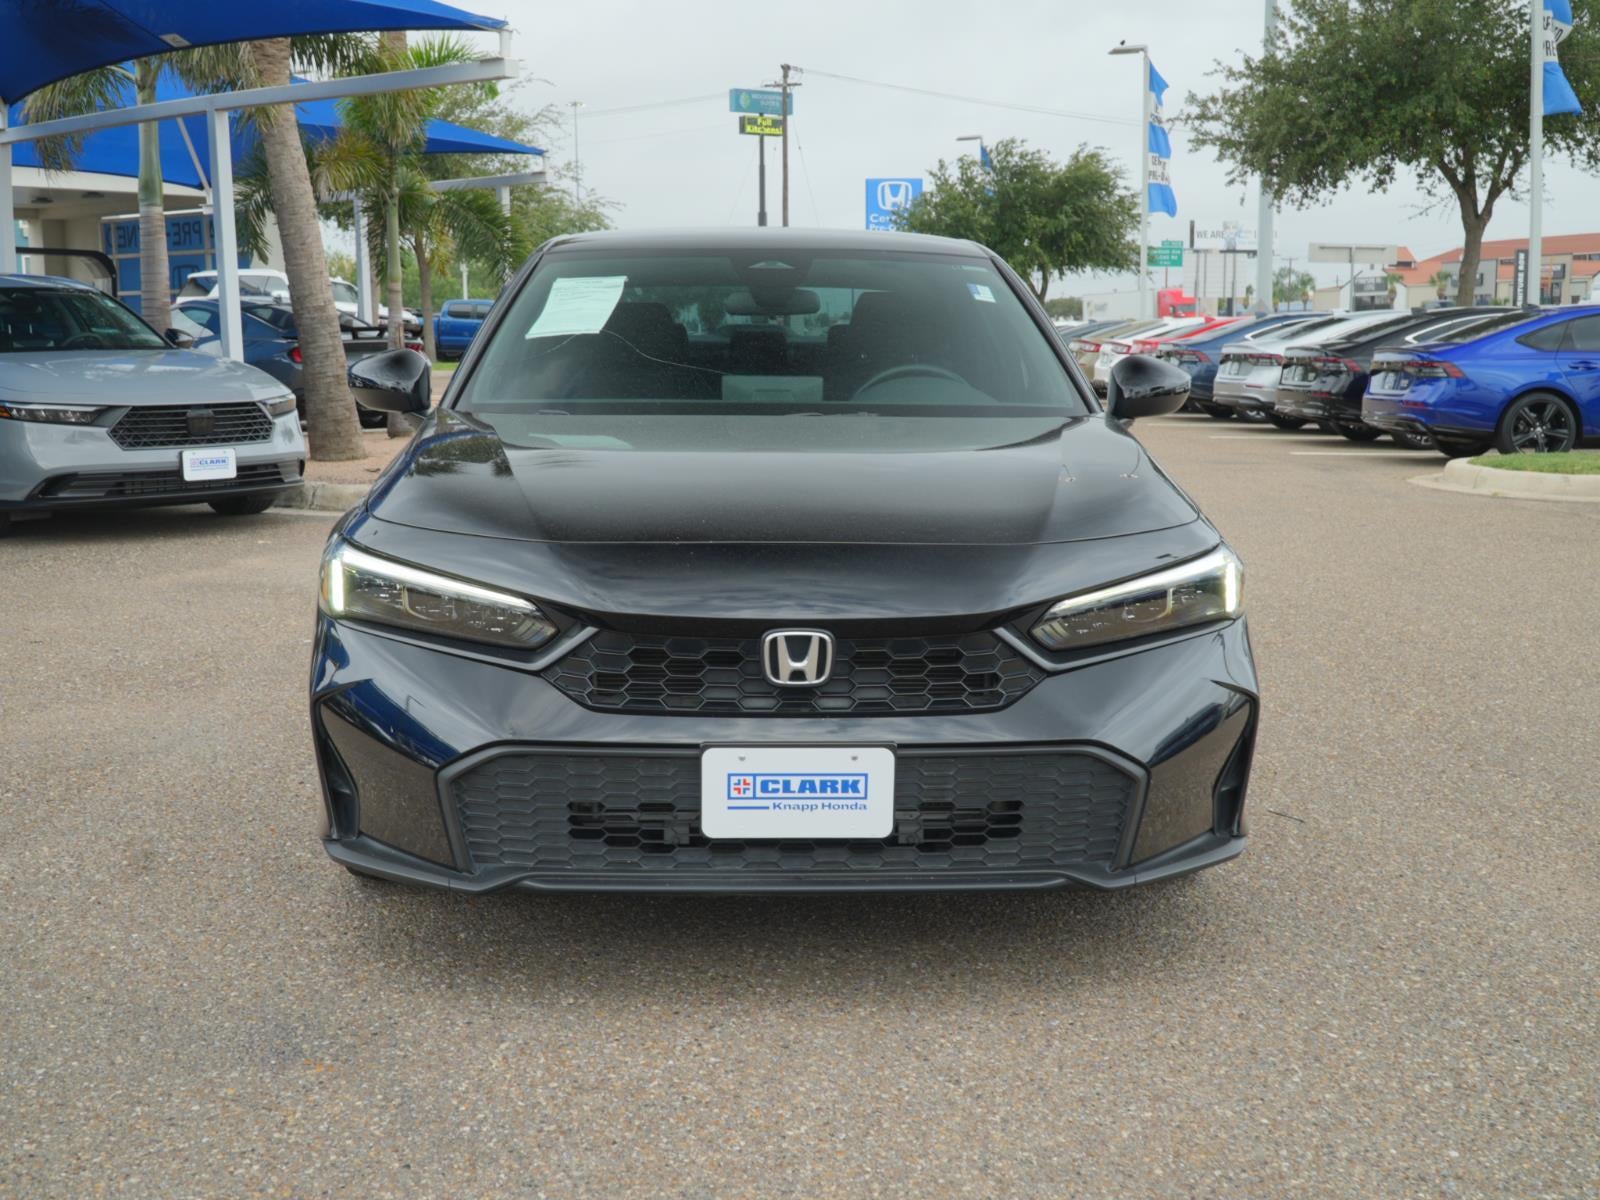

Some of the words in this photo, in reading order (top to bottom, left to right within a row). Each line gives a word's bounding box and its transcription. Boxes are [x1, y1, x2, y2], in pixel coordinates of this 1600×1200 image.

[757, 118, 773, 126] Full
[1196, 230, 1208, 239] WE
[760, 779, 861, 794] CLARK
[773, 801, 819, 812] Knapp
[822, 801, 867, 811] Honda
